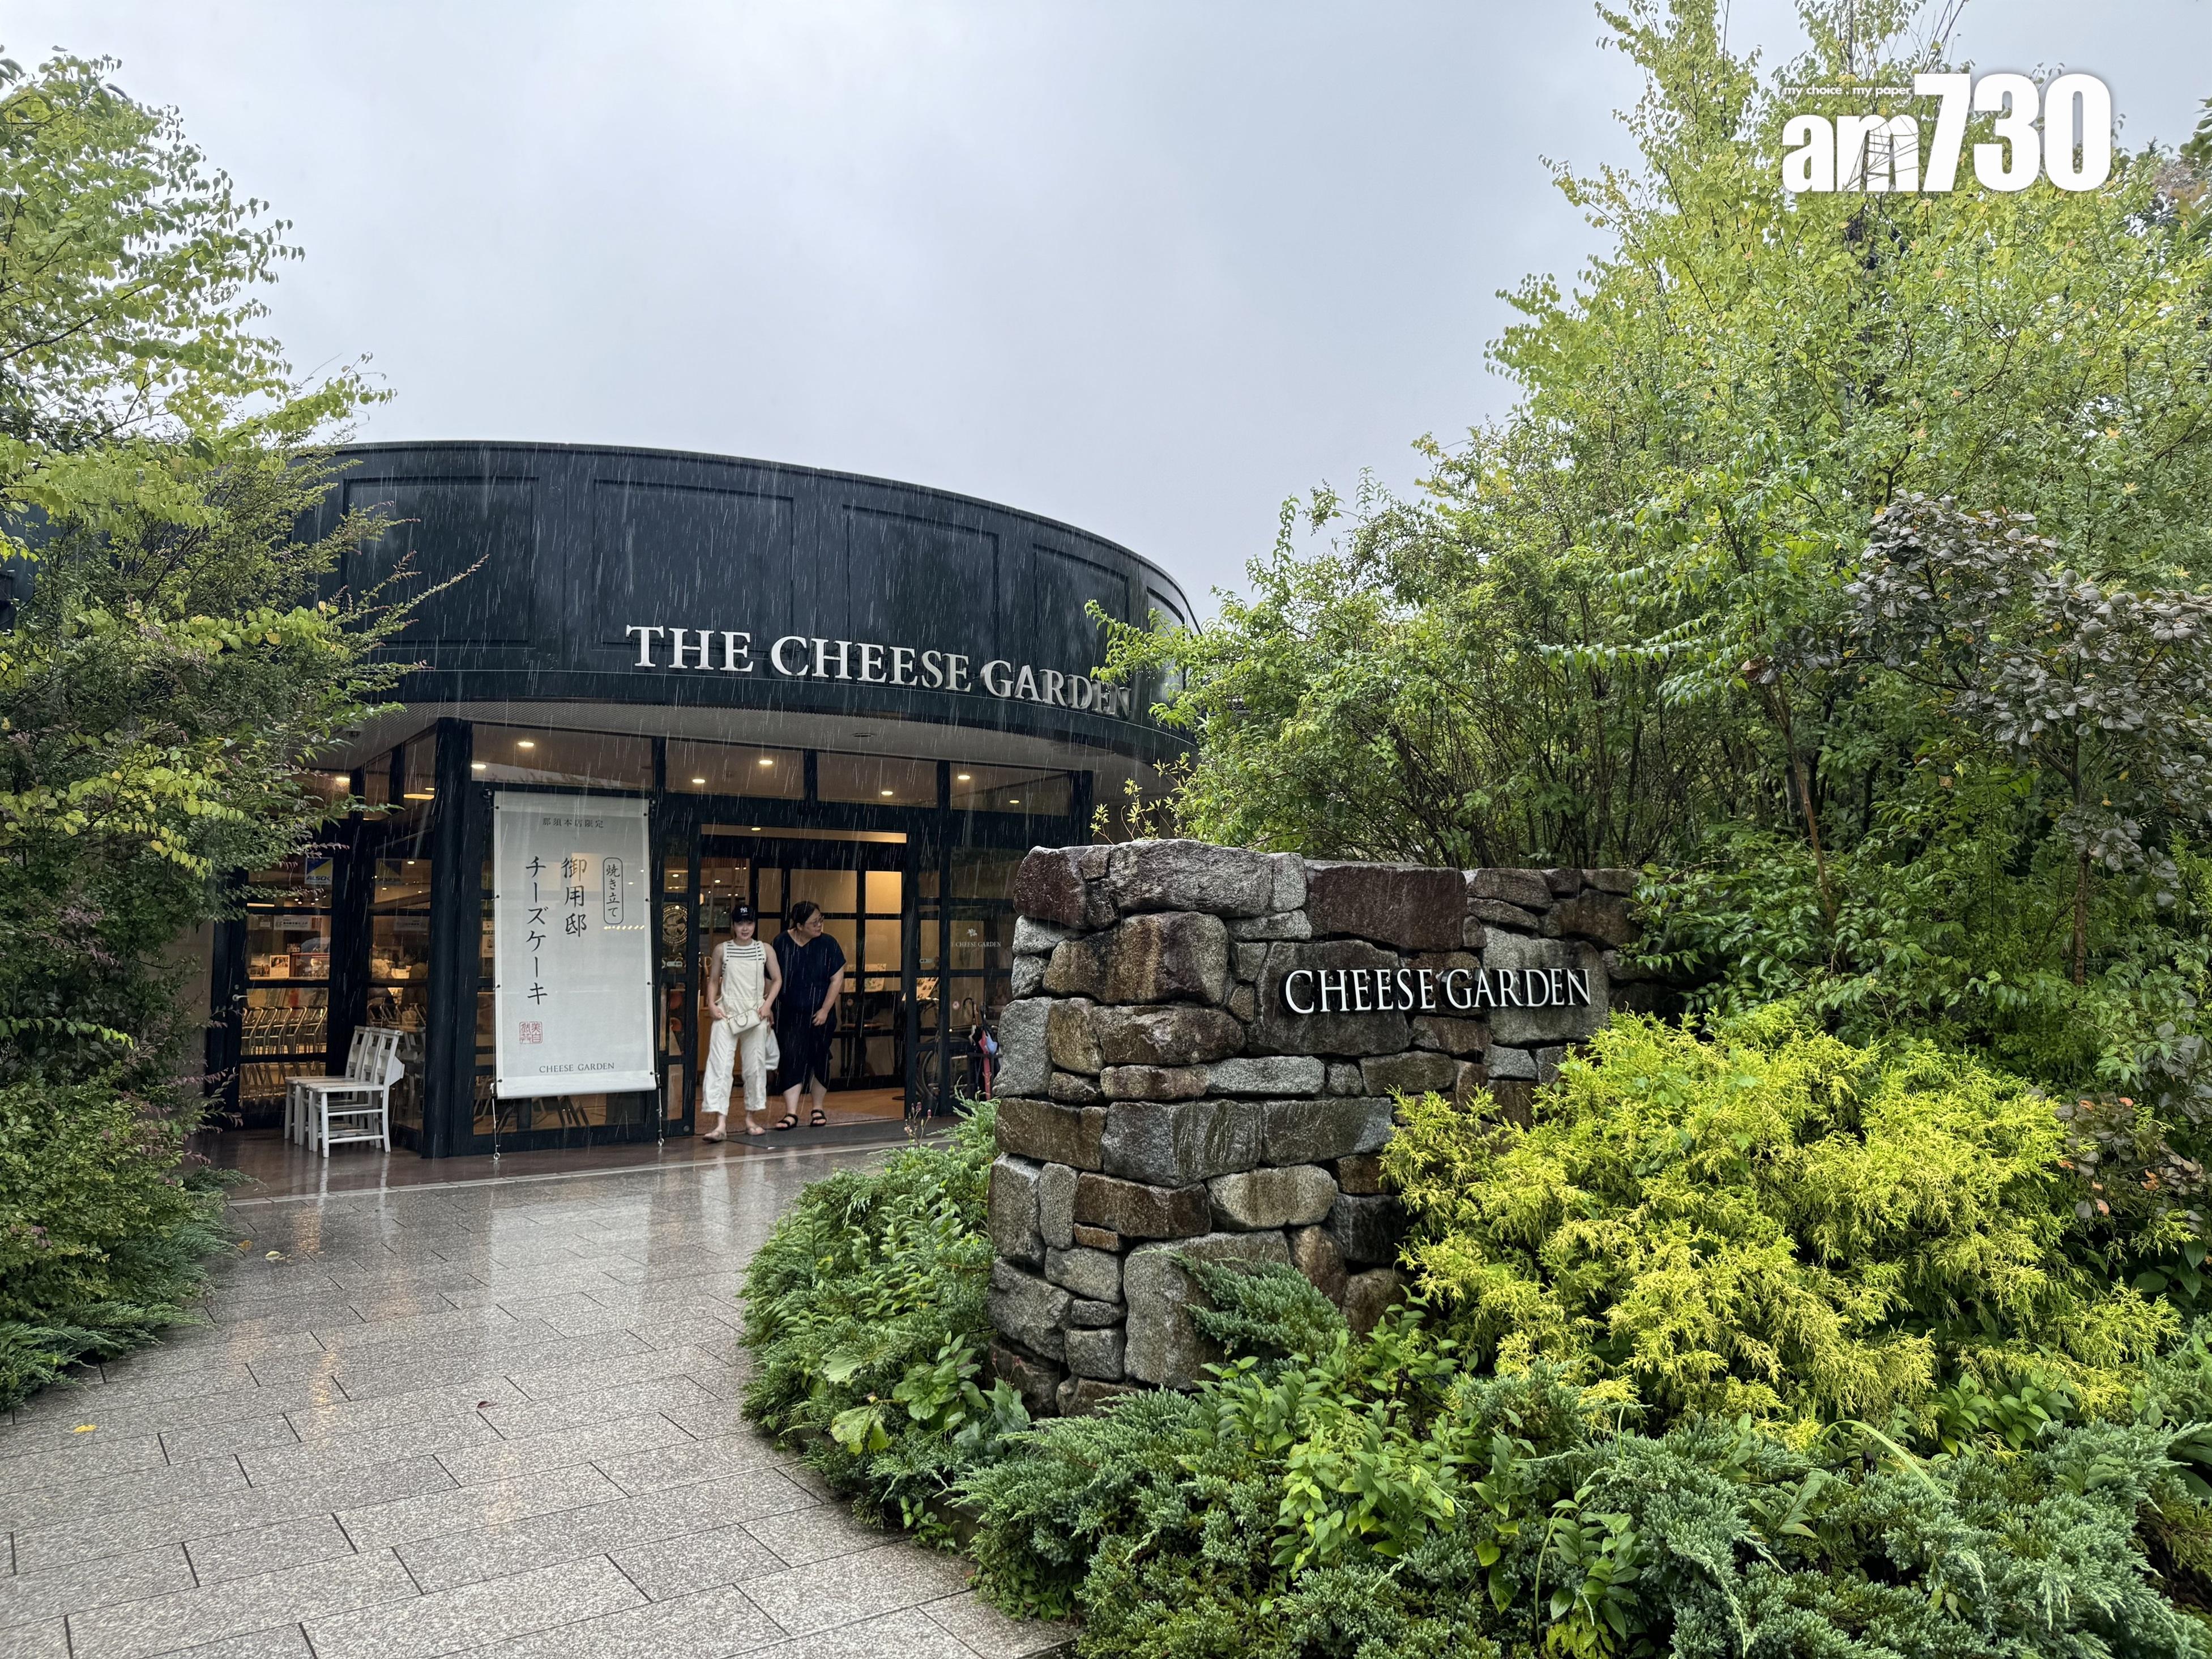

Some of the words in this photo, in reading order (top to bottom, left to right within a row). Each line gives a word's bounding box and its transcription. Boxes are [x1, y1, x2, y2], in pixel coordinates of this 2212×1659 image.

[625, 624, 754, 672] THE
[770, 635, 971, 692] CHEESE
[980, 659, 1131, 720] GARDEN
[543, 817, 604, 828] 那須本店限定
[561, 857, 587, 937] 御用邸
[606, 864, 621, 917] 焼き立て
[526, 856, 549, 1005] チーズケーキ
[1283, 969, 1436, 1014] CHEESE
[1444, 967, 1591, 1010] GARDEN
[539, 1064, 574, 1073] CHEESE
[578, 1062, 614, 1071] GARDEN
